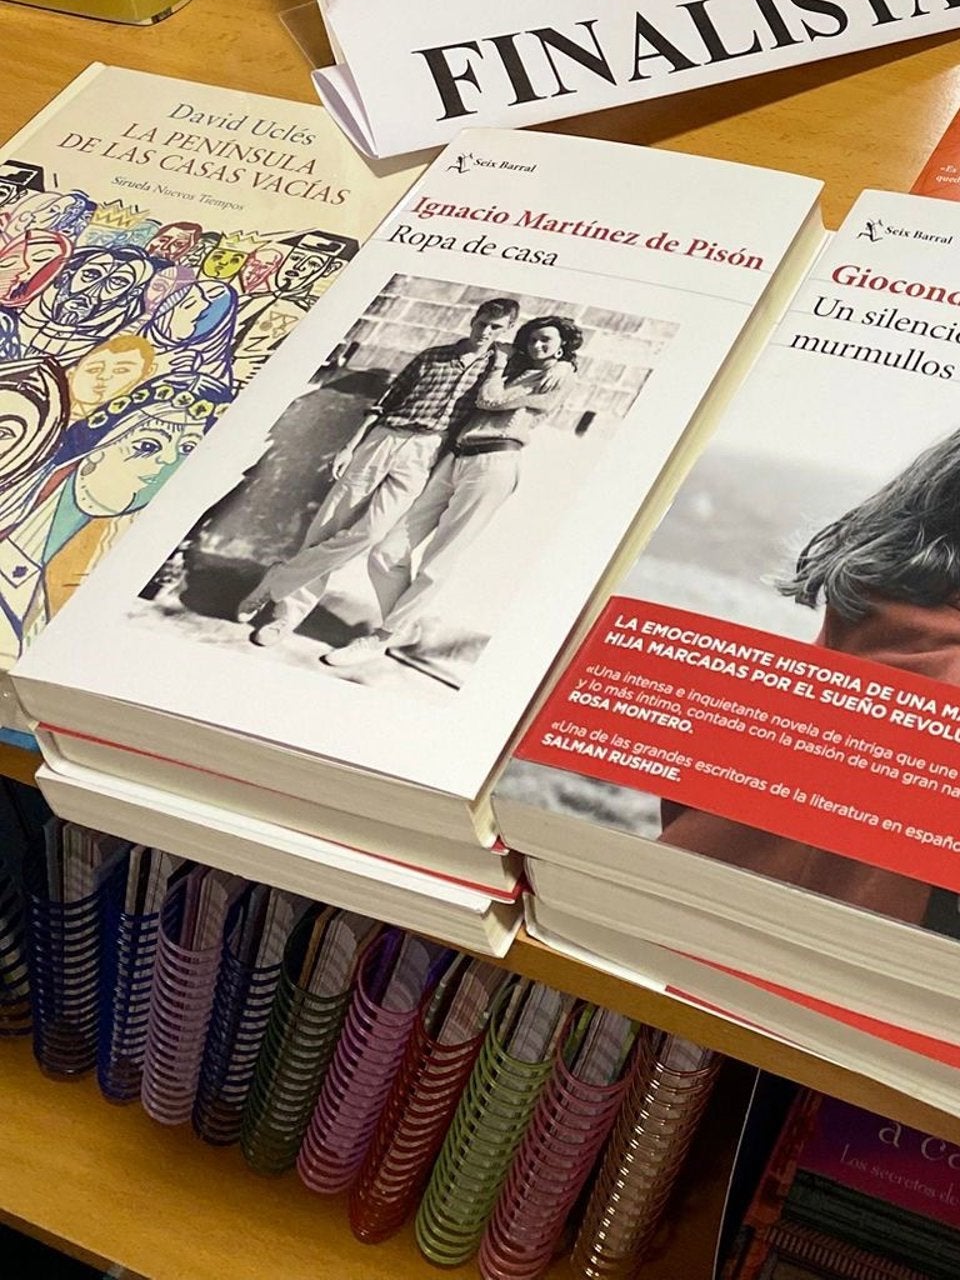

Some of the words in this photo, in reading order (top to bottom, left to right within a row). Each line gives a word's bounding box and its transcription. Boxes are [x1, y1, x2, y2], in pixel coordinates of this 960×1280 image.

[121, 123, 158, 144] LA
[163, 131, 316, 175] PENÍNSULA
[168, 103, 247, 132] David
[251, 120, 316, 146] Uclés
[58, 132, 102, 154] DE
[101, 142, 157, 166] LAS
[160, 154, 246, 184] CASAS
[250, 170, 351, 206] VACÍAS
[472, 156, 498, 170] Seix
[498, 160, 536, 174] Barral
[112, 176, 151, 192] Siruela
[154, 184, 195, 200] Nuevos
[198, 194, 244, 212] Tiempos
[385, 225, 457, 253] Ropa
[461, 234, 497, 256] de
[501, 244, 559, 268] casa
[411, 196, 510, 224] Ignacio
[515, 209, 639, 246] Martínez
[644, 234, 681, 254] de
[684, 238, 766, 271] Pisón
[884, 225, 910, 240] Seix
[912, 230, 953, 245] Barral
[811, 296, 854, 323] Un
[789, 333, 957, 381] murmullos
[605, 632, 643, 651] HIJA
[647, 643, 749, 679] MARCADAS
[751, 670, 792, 691] POR
[793, 682, 815, 699] EL
[820, 688, 887, 719] SUEÑO
[614, 615, 637, 631] LA
[641, 621, 774, 666] EMOCIONANTE
[776, 656, 861, 692] HISTORIA
[866, 682, 895, 701] DE
[896, 690, 936, 714] UNA
[568, 690, 610, 711] ROSA
[613, 702, 694, 734] MONTERO.
[576, 678, 587, 690] y
[589, 680, 601, 692] lo
[605, 684, 633, 700] más
[636, 692, 683, 717] íntimo,
[687, 706, 745, 733] contada
[748, 726, 776, 742] con
[779, 729, 791, 746] la
[794, 738, 845, 762] pasión
[847, 752, 868, 769] de
[871, 762, 900, 778] una
[902, 773, 938, 793] gran
[586, 665, 621, 681] «Una
[623, 673, 673, 694] intensa
[676, 686, 685, 698] e
[687, 687, 769, 722] inquietante
[771, 712, 819, 738] novela
[822, 727, 843, 743] de
[845, 734, 893, 760] intriga
[896, 753, 926, 770] que
[929, 763, 958, 779] une
[542, 733, 609, 760] SALMAN
[610, 751, 681, 782] RUSHDIE.
[552, 720, 587, 738] «Una
[590, 728, 608, 743] de
[611, 734, 631, 750] las
[633, 740, 693, 768] grandes
[695, 760, 767, 791] escritoras
[770, 783, 790, 798] de
[792, 786, 806, 803] la
[810, 793, 880, 826] literatura
[882, 818, 902, 834] en
